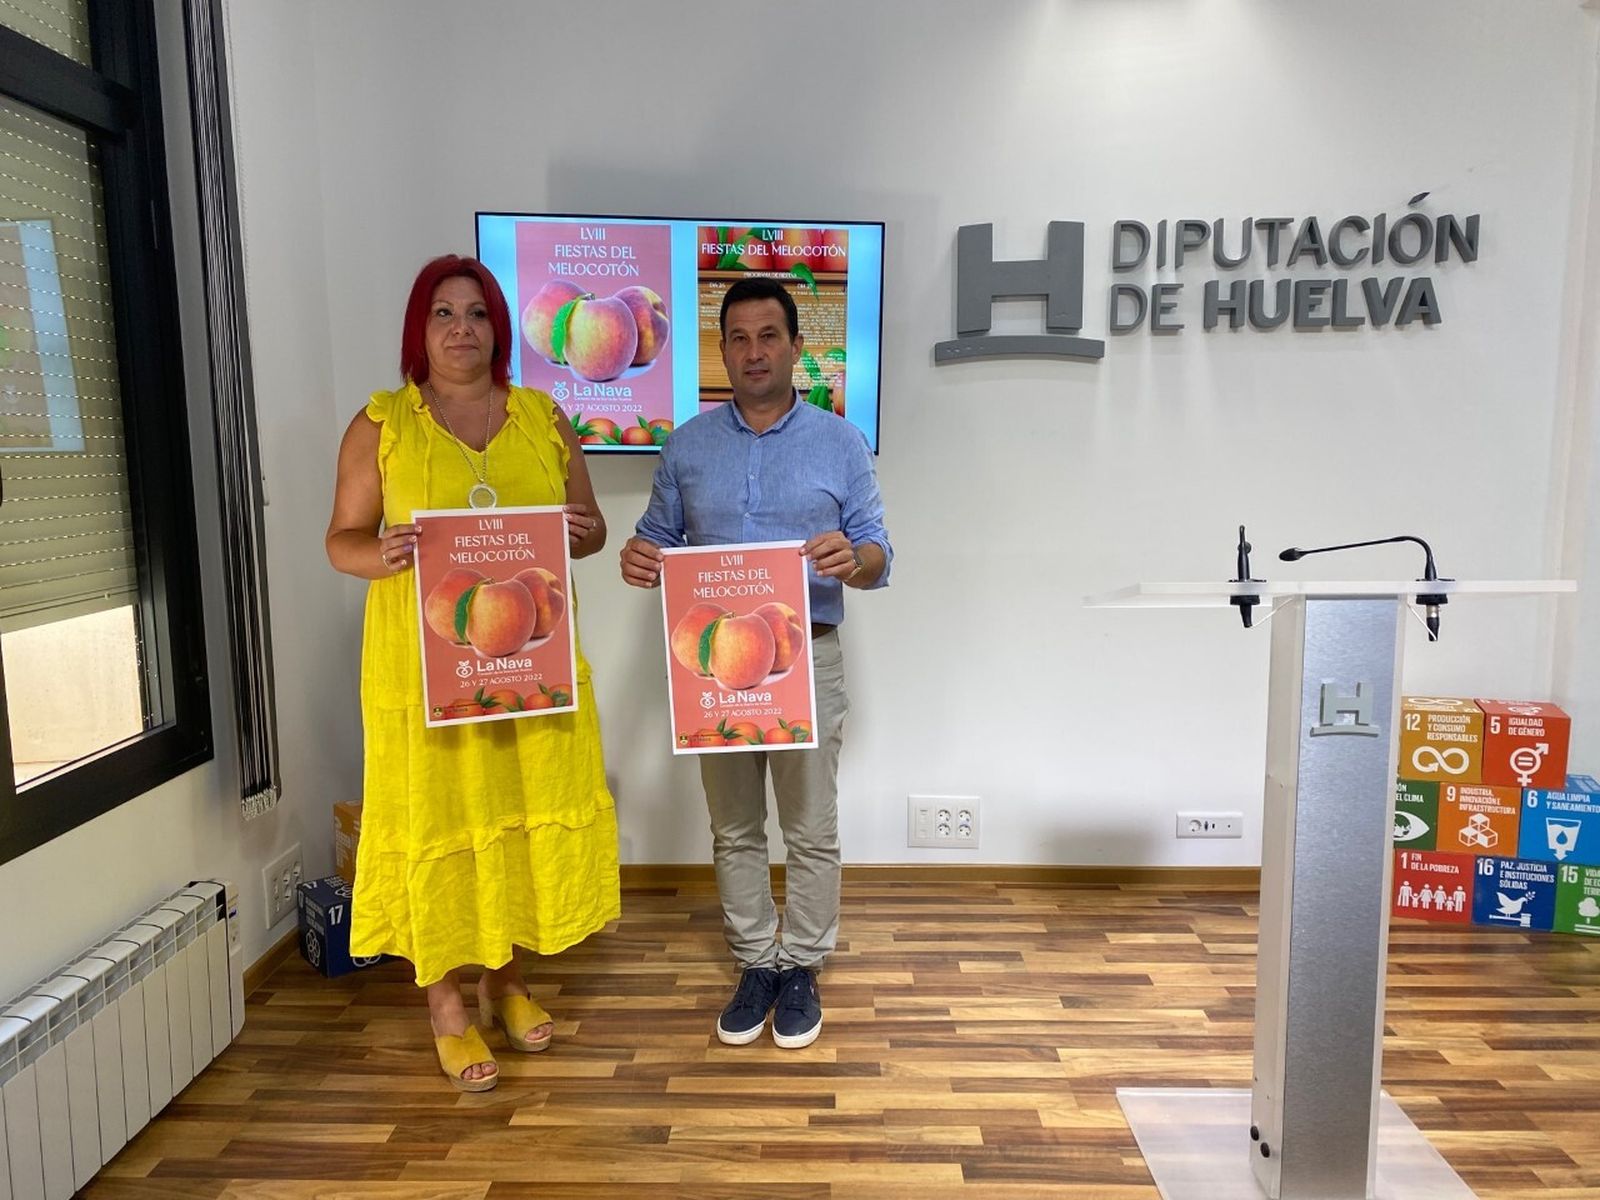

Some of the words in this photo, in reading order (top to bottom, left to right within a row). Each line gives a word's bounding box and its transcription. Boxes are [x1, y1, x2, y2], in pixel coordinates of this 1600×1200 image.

[580, 228, 606, 240] LVIII
[762, 230, 784, 240] LVIII
[1112, 191, 1481, 272] DIPUTACIÓN
[554, 244, 607, 258] FIESTAS
[610, 246, 636, 260] DEL
[701, 244, 745, 256] FIESTAS
[748, 244, 769, 256] DEL
[772, 243, 846, 257] MELOCOTÓN
[548, 261, 640, 276] MELOCOTÓN
[1109, 283, 1185, 334] DE
[1204, 276, 1443, 332] HUELVA
[573, 383, 592, 396] La
[594, 384, 632, 397] Nava
[587, 404, 620, 412] AGOSTO
[479, 518, 504, 531] LVIII
[455, 535, 504, 547] FIESTAS
[508, 534, 532, 546] DEL
[450, 547, 535, 564] MELOCOTÓN
[720, 554, 744, 566] LVIII
[698, 570, 745, 583] FIESTAS
[748, 568, 771, 580] DEL
[693, 582, 775, 598] MELOCOTÓN
[476, 660, 494, 672] La
[496, 658, 532, 670] Nava
[490, 675, 522, 685] AGOSTO
[523, 673, 543, 682] 2022
[719, 692, 736, 704] La
[737, 691, 772, 702] Nava
[731, 709, 762, 717] AGOSTO
[763, 707, 782, 716] 2022
[1404, 713, 1421, 731] 12
[1428, 714, 1471, 724] PRODUCCIÓN
[1490, 716, 1500, 734] 5
[1508, 717, 1543, 727] IGUALDAD
[1432, 724, 1466, 732] CONSUMO
[1508, 727, 1517, 735] DE
[1518, 726, 1545, 736] GÉNERO
[1427, 732, 1478, 742] RESPONSABLES
[1404, 794, 1424, 803] CLIMA
[1446, 786, 1456, 802] 9
[1460, 795, 1496, 804] INNOVACIÓN
[1527, 790, 1538, 808] 6
[1546, 792, 1566, 800] AGUA
[1566, 793, 1591, 803] LIMPIA
[1459, 804, 1516, 814] INFRAESTRUCTURA
[1546, 801, 1551, 809] Y
[1401, 852, 1408, 869] 1
[1412, 853, 1422, 861] FIN
[1411, 862, 1419, 870] DE
[1420, 863, 1428, 871] LA
[1429, 864, 1460, 874] POBREZA
[1477, 858, 1494, 876] 16
[1516, 862, 1547, 872] JUSTICIA
[1500, 870, 1504, 878] E
[1505, 871, 1555, 883] INSTITUCIONES
[1561, 865, 1578, 883] 15
[1500, 879, 1528, 890] SÓLIDAS
[328, 904, 344, 926] 17
